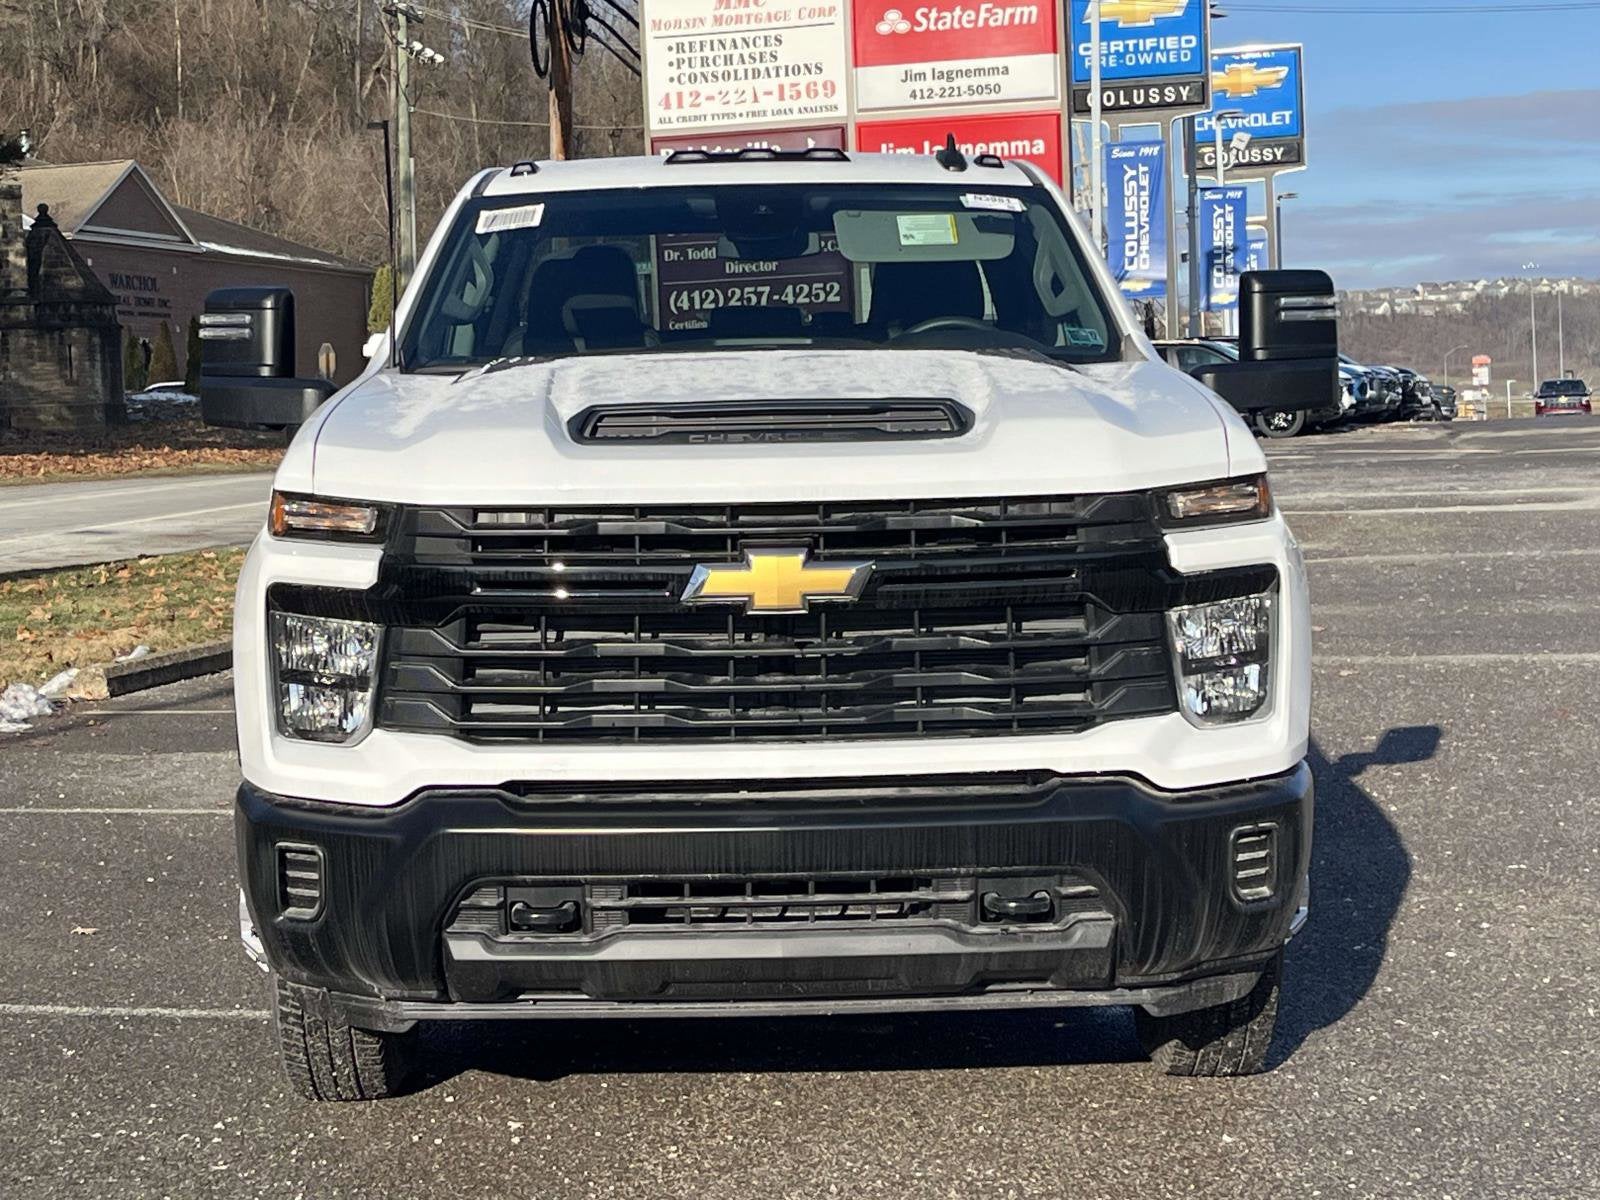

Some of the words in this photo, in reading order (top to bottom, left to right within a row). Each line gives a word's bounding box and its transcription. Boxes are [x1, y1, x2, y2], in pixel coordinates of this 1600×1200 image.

[711, 9, 792, 28] MORTGAGE
[675, 34, 784, 54] REFINANCES
[1078, 35, 1197, 56] CERTIFIED
[676, 50, 779, 70] PURCHASES
[1084, 50, 1191, 69] PRE-OWNED
[677, 62, 824, 85] CONSOLIDATIONS
[901, 70, 927, 83] Jim
[658, 79, 837, 111] 412-221-1569
[909, 83, 1002, 101] 412-221-5050
[657, 116, 674, 125] ALL
[676, 112, 708, 124] CREDIT
[711, 111, 737, 122] TYPES
[746, 109, 768, 119] FREE
[771, 107, 794, 117] LOAN
[797, 103, 839, 115] ANALYSIS
[1123, 164, 1138, 271] COLUSSY
[1138, 163, 1150, 270] CHEVROLET
[664, 249, 684, 262] Dr.
[688, 247, 717, 261] Todd
[1213, 204, 1225, 288] COLUSSY
[1225, 203, 1234, 288] CHEVROLET
[725, 260, 779, 274] Director
[669, 288, 724, 315] (412)
[727, 281, 841, 306] 257-4252
